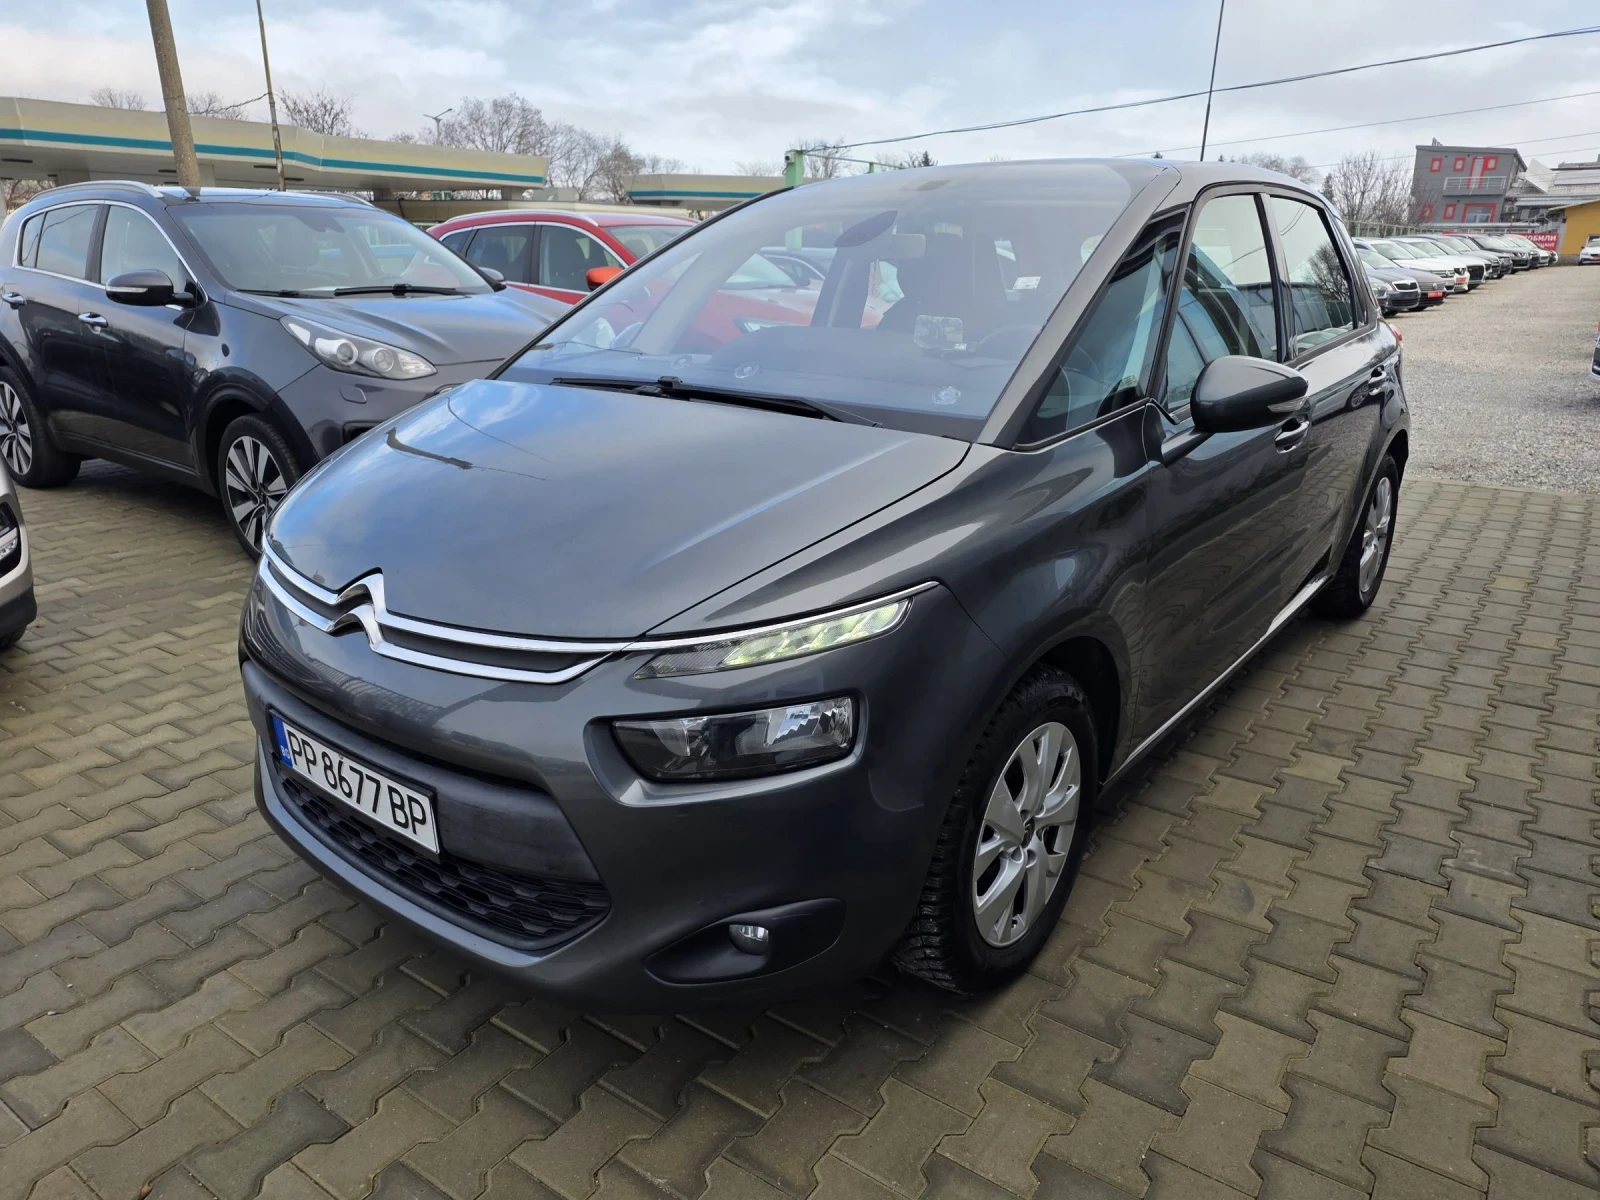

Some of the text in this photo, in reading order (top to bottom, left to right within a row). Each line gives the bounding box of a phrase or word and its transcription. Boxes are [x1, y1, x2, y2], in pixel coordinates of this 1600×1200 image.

[281, 745, 291, 759] BG
[286, 729, 427, 835] PP 8677 BP
